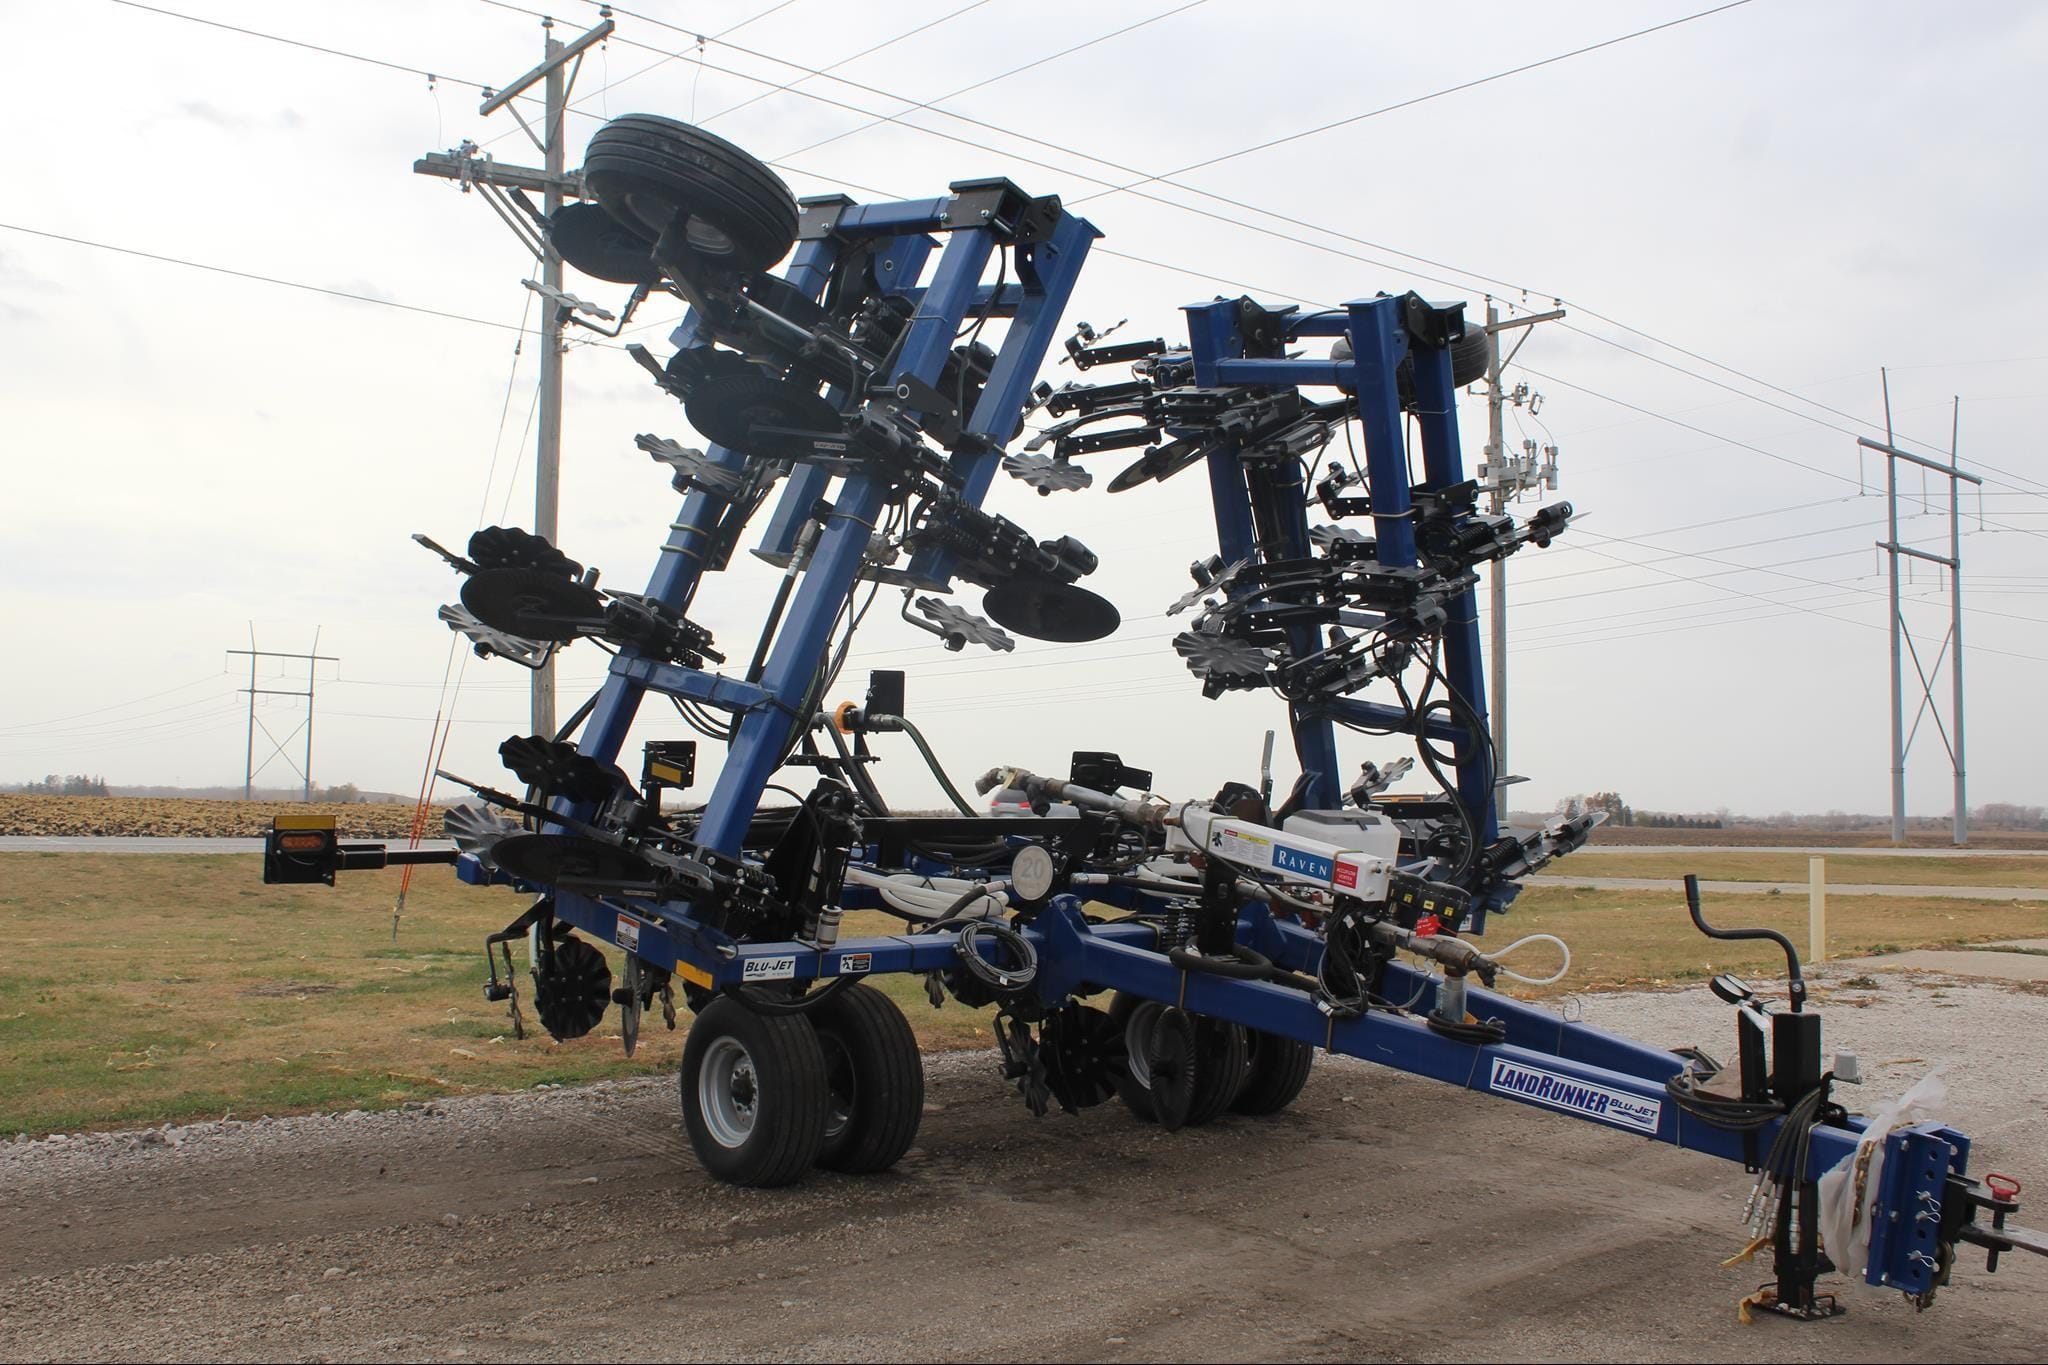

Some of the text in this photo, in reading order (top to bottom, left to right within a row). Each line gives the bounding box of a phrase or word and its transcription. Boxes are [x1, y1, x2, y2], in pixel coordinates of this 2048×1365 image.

[1020, 857, 1044, 879] 20
[745, 960, 795, 972] BLU-JET
[1609, 1098, 1658, 1118] BLU-JET
